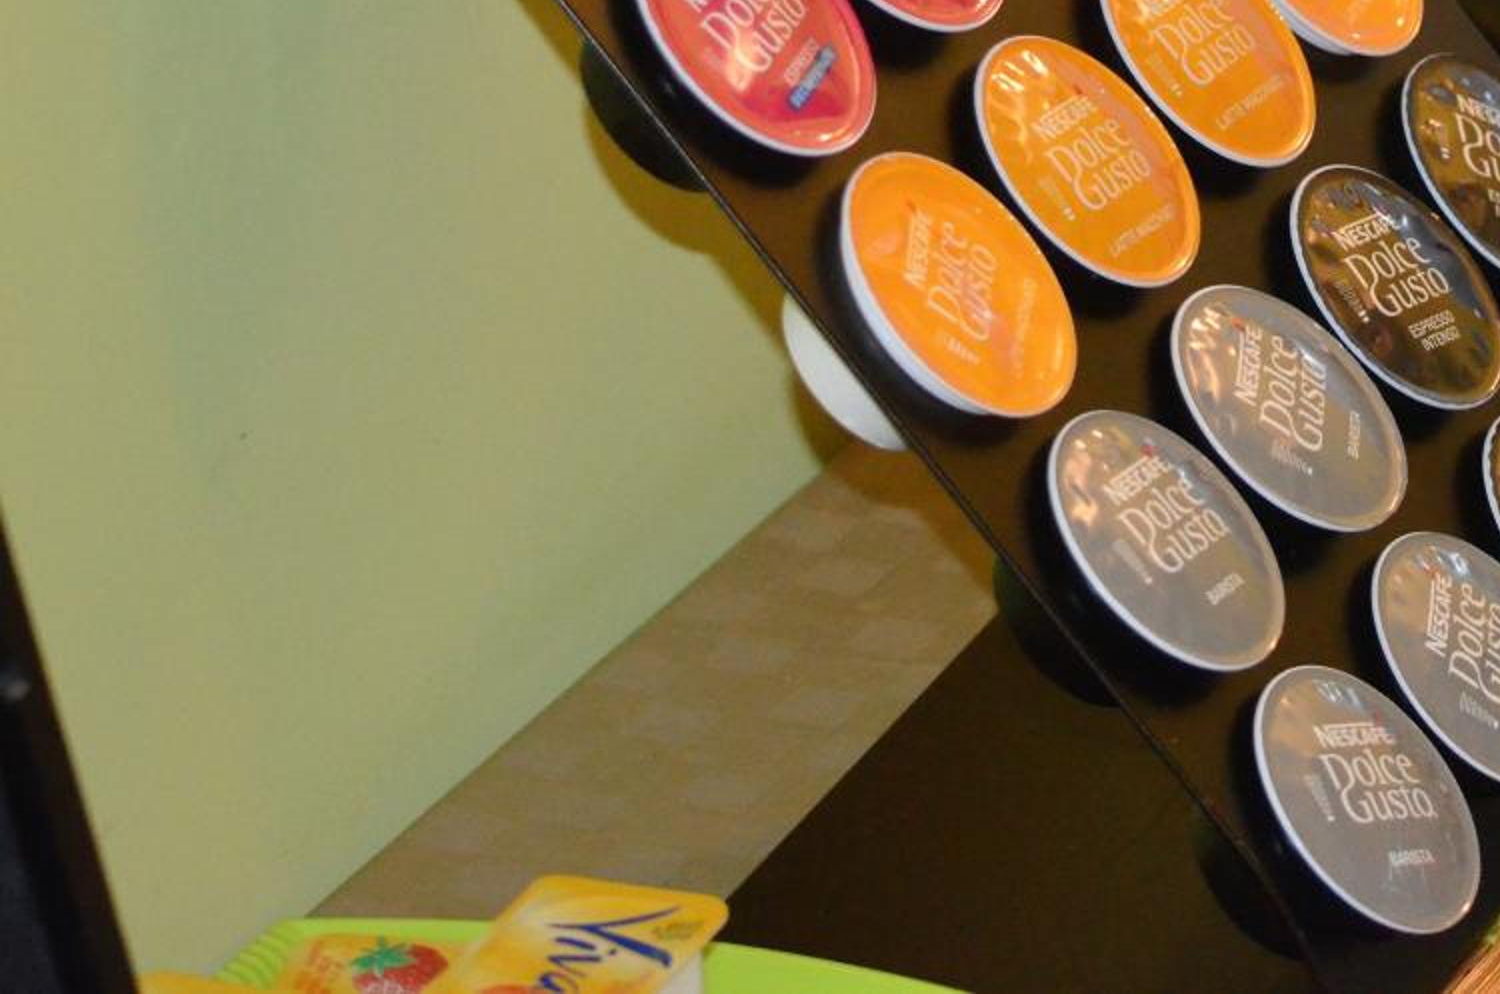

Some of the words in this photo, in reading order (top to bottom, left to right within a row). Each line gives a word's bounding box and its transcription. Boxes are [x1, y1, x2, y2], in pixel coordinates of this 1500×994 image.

[1179, 22, 1257, 86] Gusto
[1045, 119, 1131, 183] Dolce
[1072, 149, 1152, 210] Gusto
[1342, 236, 1432, 288] Dolce
[1369, 265, 1454, 317] Gusto
[1408, 309, 1455, 340] ESPRESSO
[1420, 325, 1461, 352] INTENSO
[1259, 334, 1299, 438] Dolce
[1290, 347, 1328, 452] Gusto
[1117, 474, 1206, 546] Dolce
[1149, 508, 1232, 574] Gusto
[1447, 582, 1488, 689] Dolce
[1317, 748, 1422, 791] Dolce
[1339, 786, 1440, 824] Gusto
